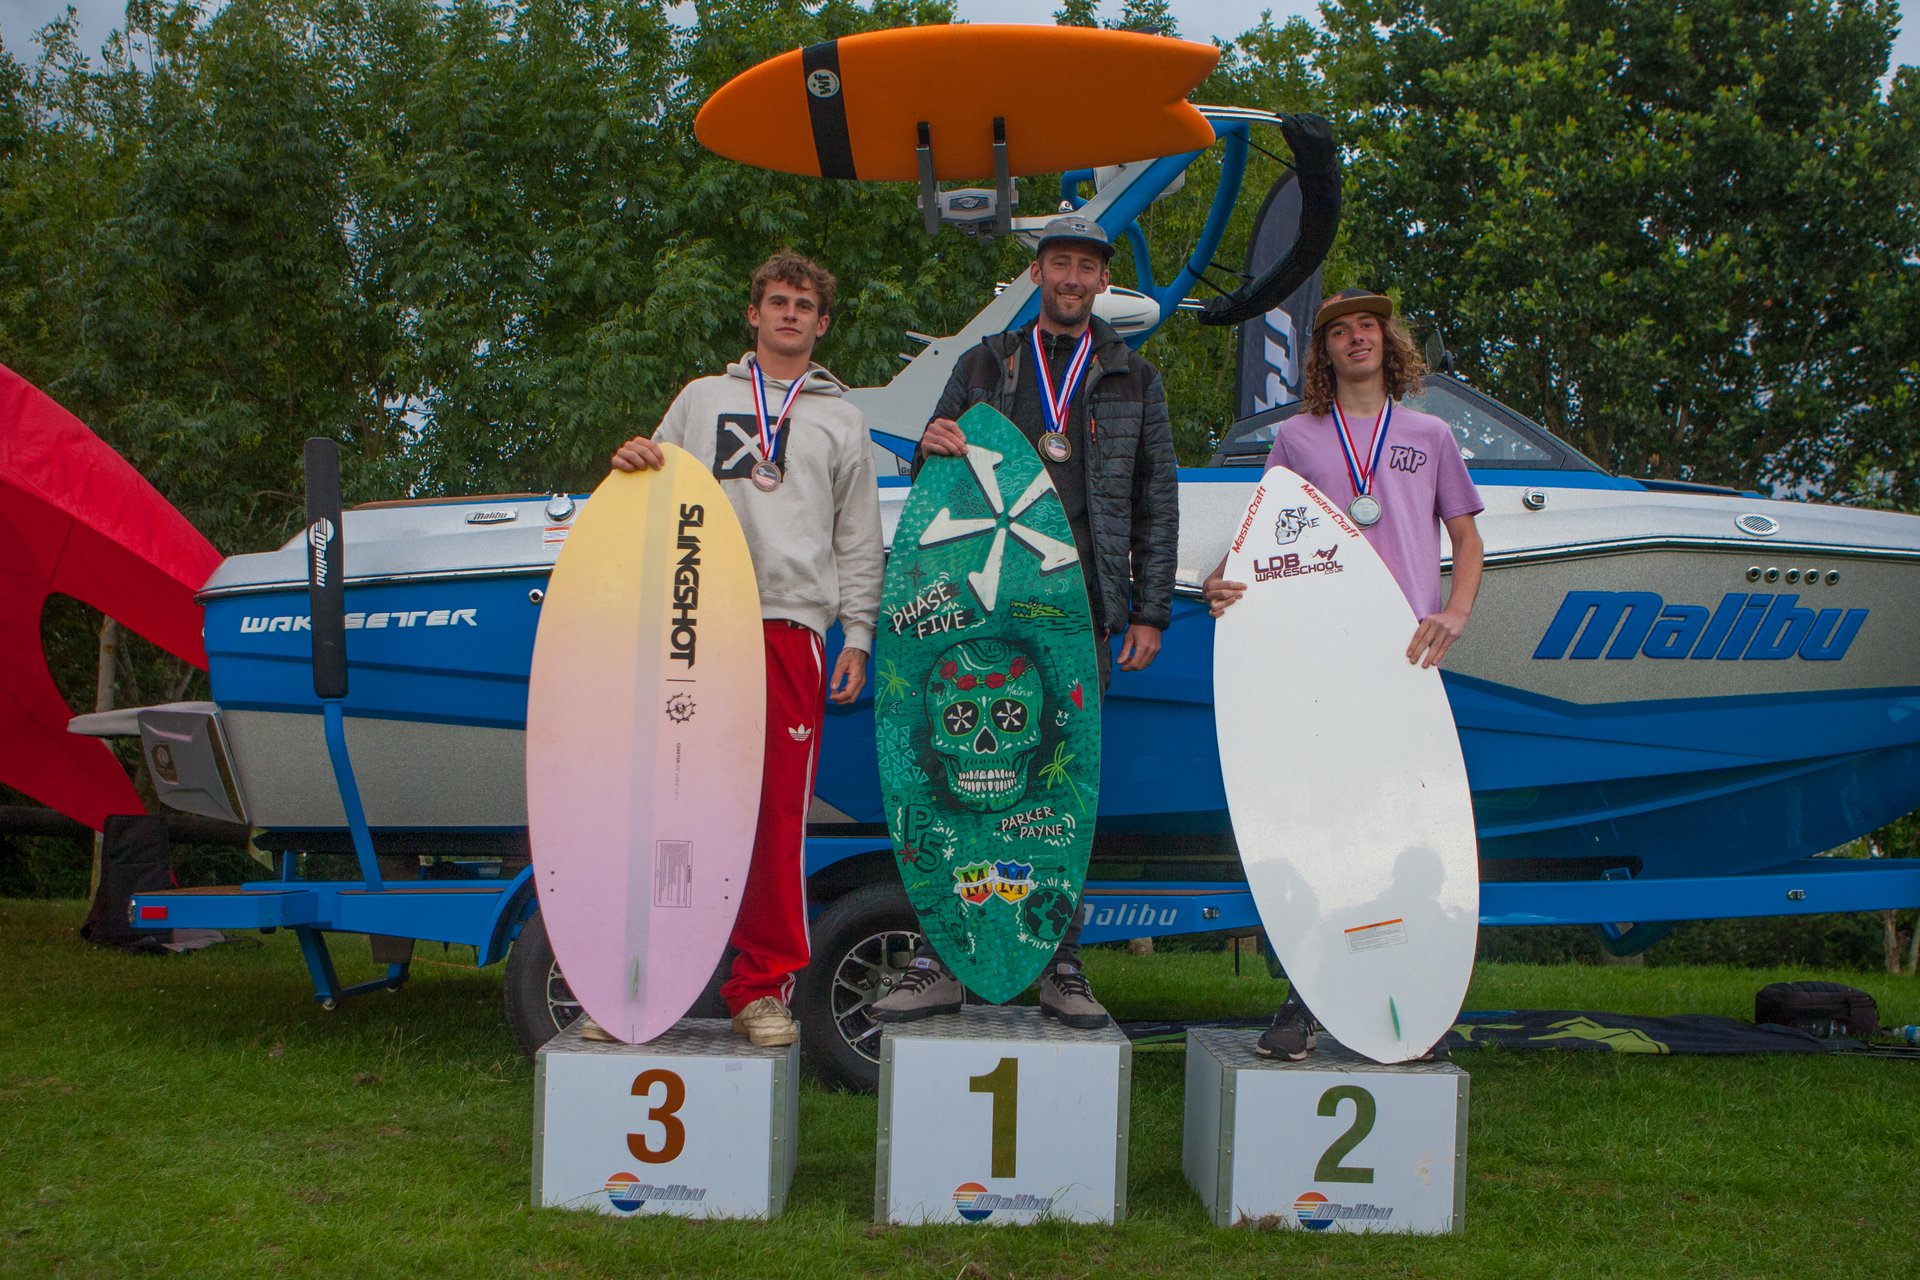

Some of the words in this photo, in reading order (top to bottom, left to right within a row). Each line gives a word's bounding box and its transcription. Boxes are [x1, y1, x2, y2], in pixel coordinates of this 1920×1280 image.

[1390, 446, 1427, 474] RIP
[1231, 485, 1267, 554] MasterCraft
[1300, 483, 1360, 539] MasterCraft
[1253, 552, 1300, 574] LDB
[1254, 560, 1343, 583] WAKESCHOOL
[670, 503, 704, 670] SLINGSHOT
[240, 608, 478, 634] WAKSETTER
[892, 581, 951, 636] PHASE
[917, 610, 966, 640] FIVE
[1531, 590, 1870, 661] Malibu
[1000, 806, 1055, 832] PARKER
[1019, 824, 1063, 840] PAYNE
[627, 1069, 686, 1164] 3
[969, 1057, 1018, 1178] 1
[1313, 1085, 1377, 1184] 2
[624, 1183, 707, 1201] Malibu
[972, 1194, 1054, 1210] Malibu
[1312, 1203, 1394, 1220] Malibu
